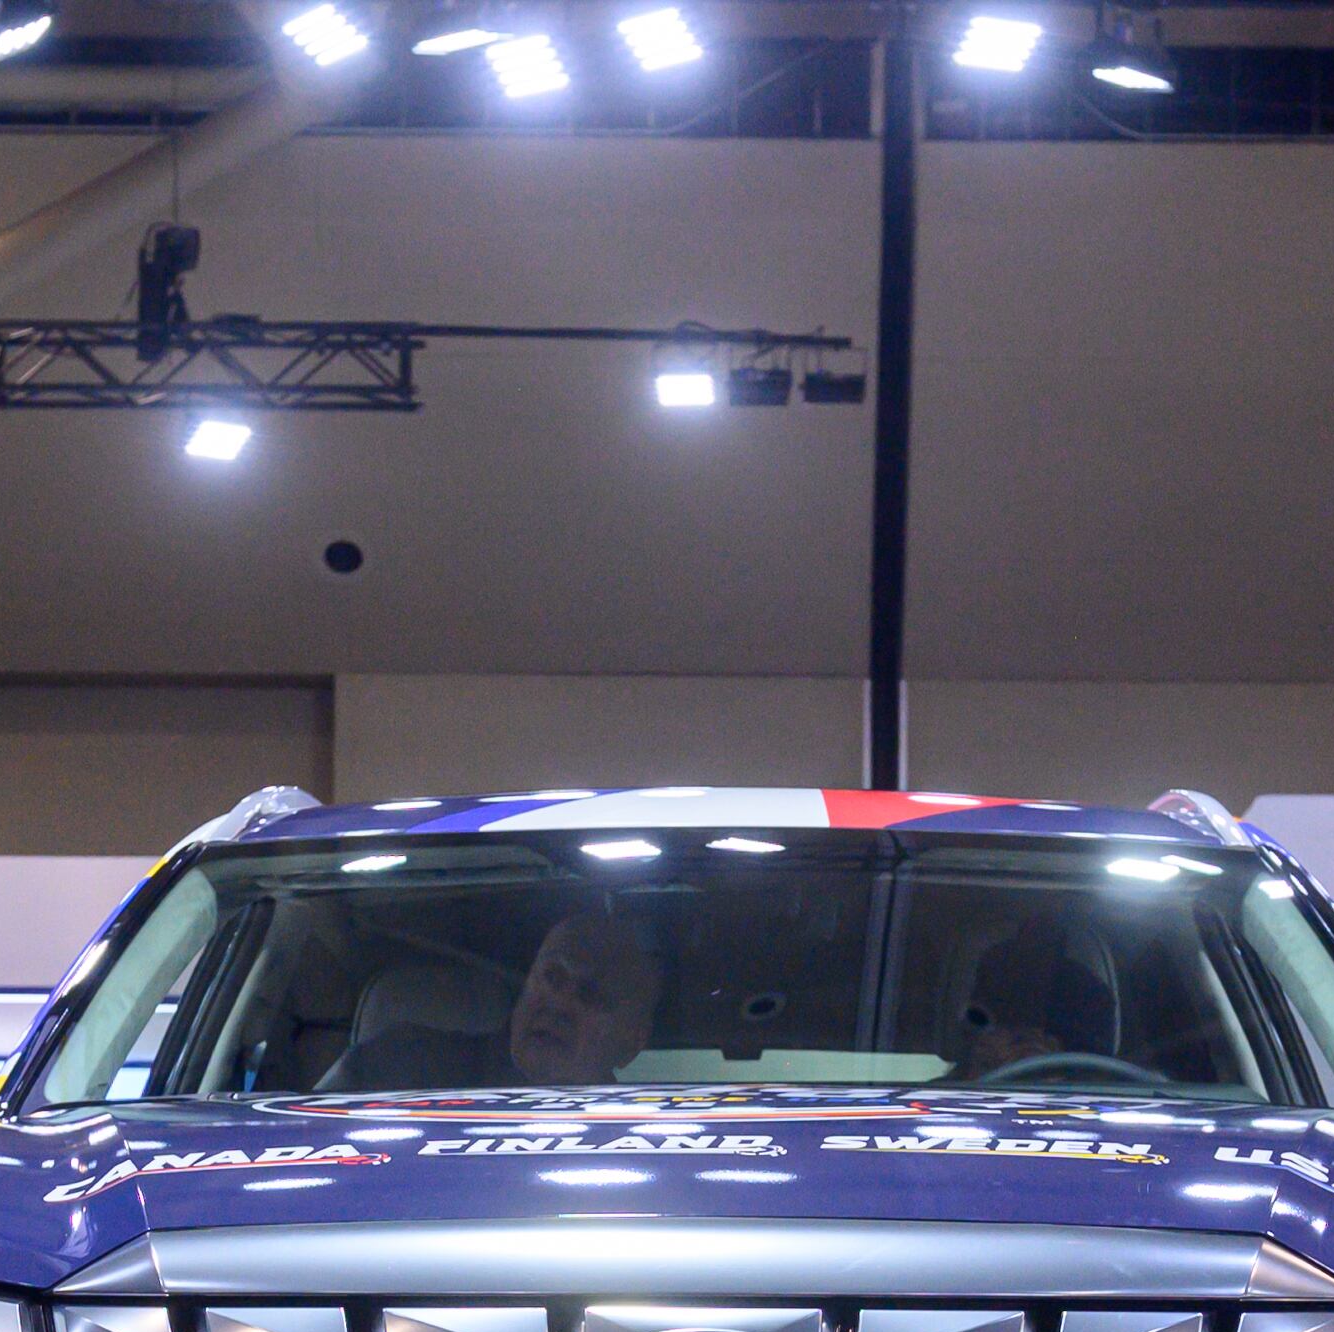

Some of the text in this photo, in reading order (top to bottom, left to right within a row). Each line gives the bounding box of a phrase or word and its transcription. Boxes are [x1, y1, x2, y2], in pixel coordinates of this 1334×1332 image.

[43, 1144, 362, 1202] CANADA
[418, 1135, 773, 1154] FINLAND
[820, 1135, 1152, 1155] SWEDEN
